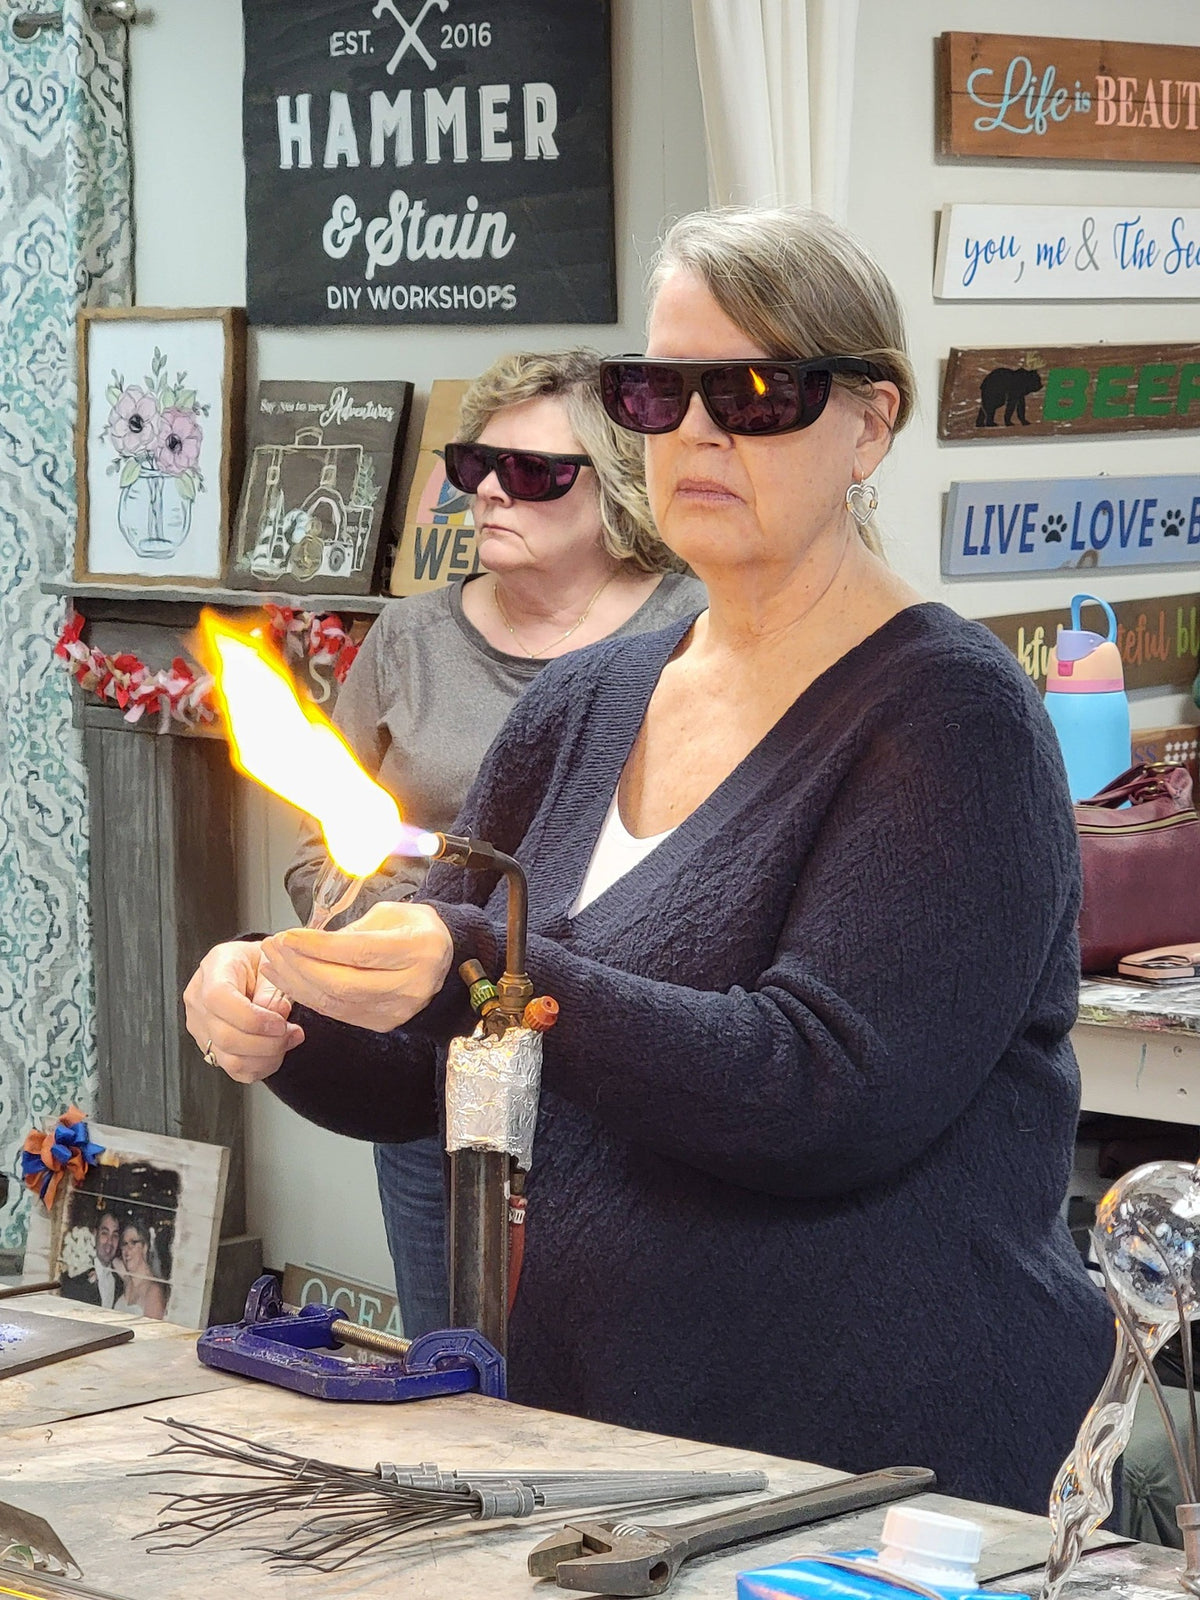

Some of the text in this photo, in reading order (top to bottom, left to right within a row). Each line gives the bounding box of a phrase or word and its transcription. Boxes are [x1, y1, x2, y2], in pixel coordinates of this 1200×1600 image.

[330, 22, 492, 57] EST. 2016
[967, 56, 1200, 135] Life is BEAUT
[277, 82, 560, 169] HAMMER
[322, 189, 516, 280] & Stain
[962, 214, 1200, 286] you, me & The Se
[327, 283, 517, 310] DIY WORKSHOPS
[319, 386, 395, 428] Adventures
[414, 527, 480, 580] WE
[963, 503, 1039, 556] LIVE
[1070, 499, 1158, 551] LOVE
